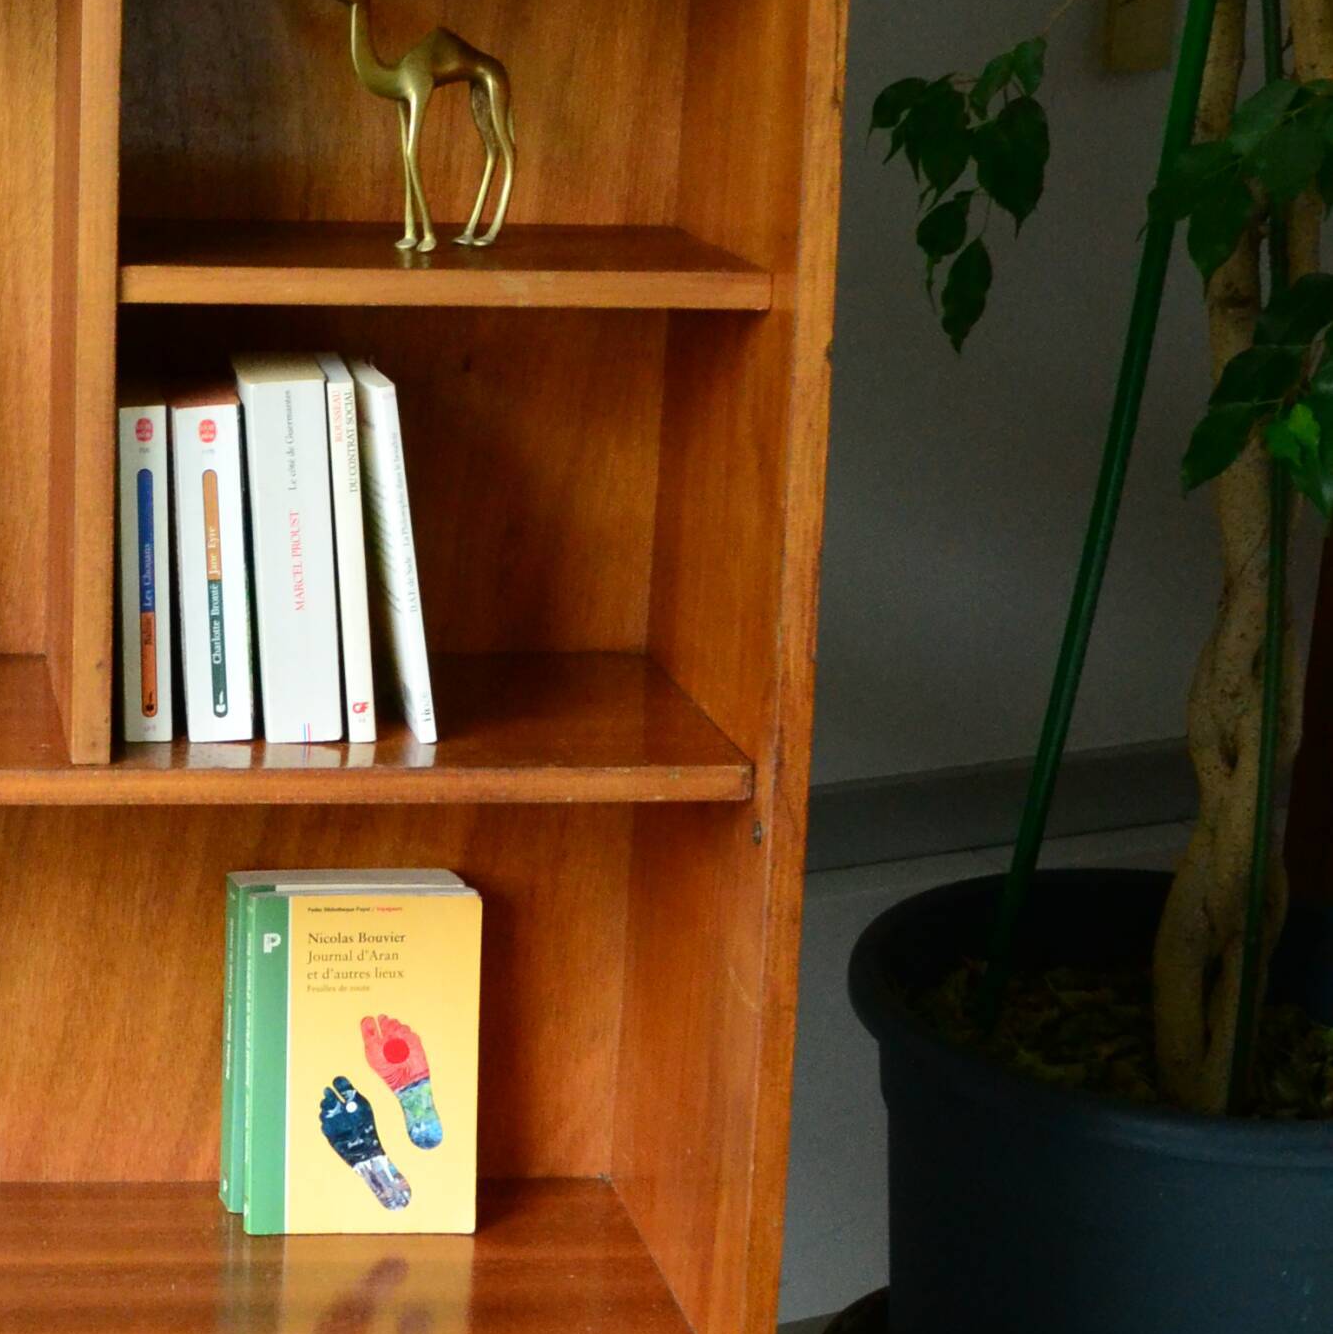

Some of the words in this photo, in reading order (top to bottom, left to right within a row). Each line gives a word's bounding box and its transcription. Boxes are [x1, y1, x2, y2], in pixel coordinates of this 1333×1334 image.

[284, 389, 295, 441] Guermantes
[330, 390, 344, 443] ROUSSEAU
[343, 391, 356, 425] SOCIAL
[287, 442, 296, 457] de
[345, 426, 358, 474] CONTRAT
[288, 478, 298, 491] Le
[349, 475, 359, 493] DU
[207, 526, 220, 548] Eyre
[289, 510, 303, 557] PROUST
[209, 554, 221, 575] Jane
[291, 561, 306, 612] MARCEL
[211, 620, 223, 665] Charlotte
[308, 932, 354, 945] Nicolas
[358, 931, 406, 944] Bouvier
[306, 949, 354, 965] Journal
[356, 948, 400, 962] d'Aran
[306, 970, 318, 980] et
[322, 967, 371, 980] d'autres
[374, 966, 405, 980] lieux
